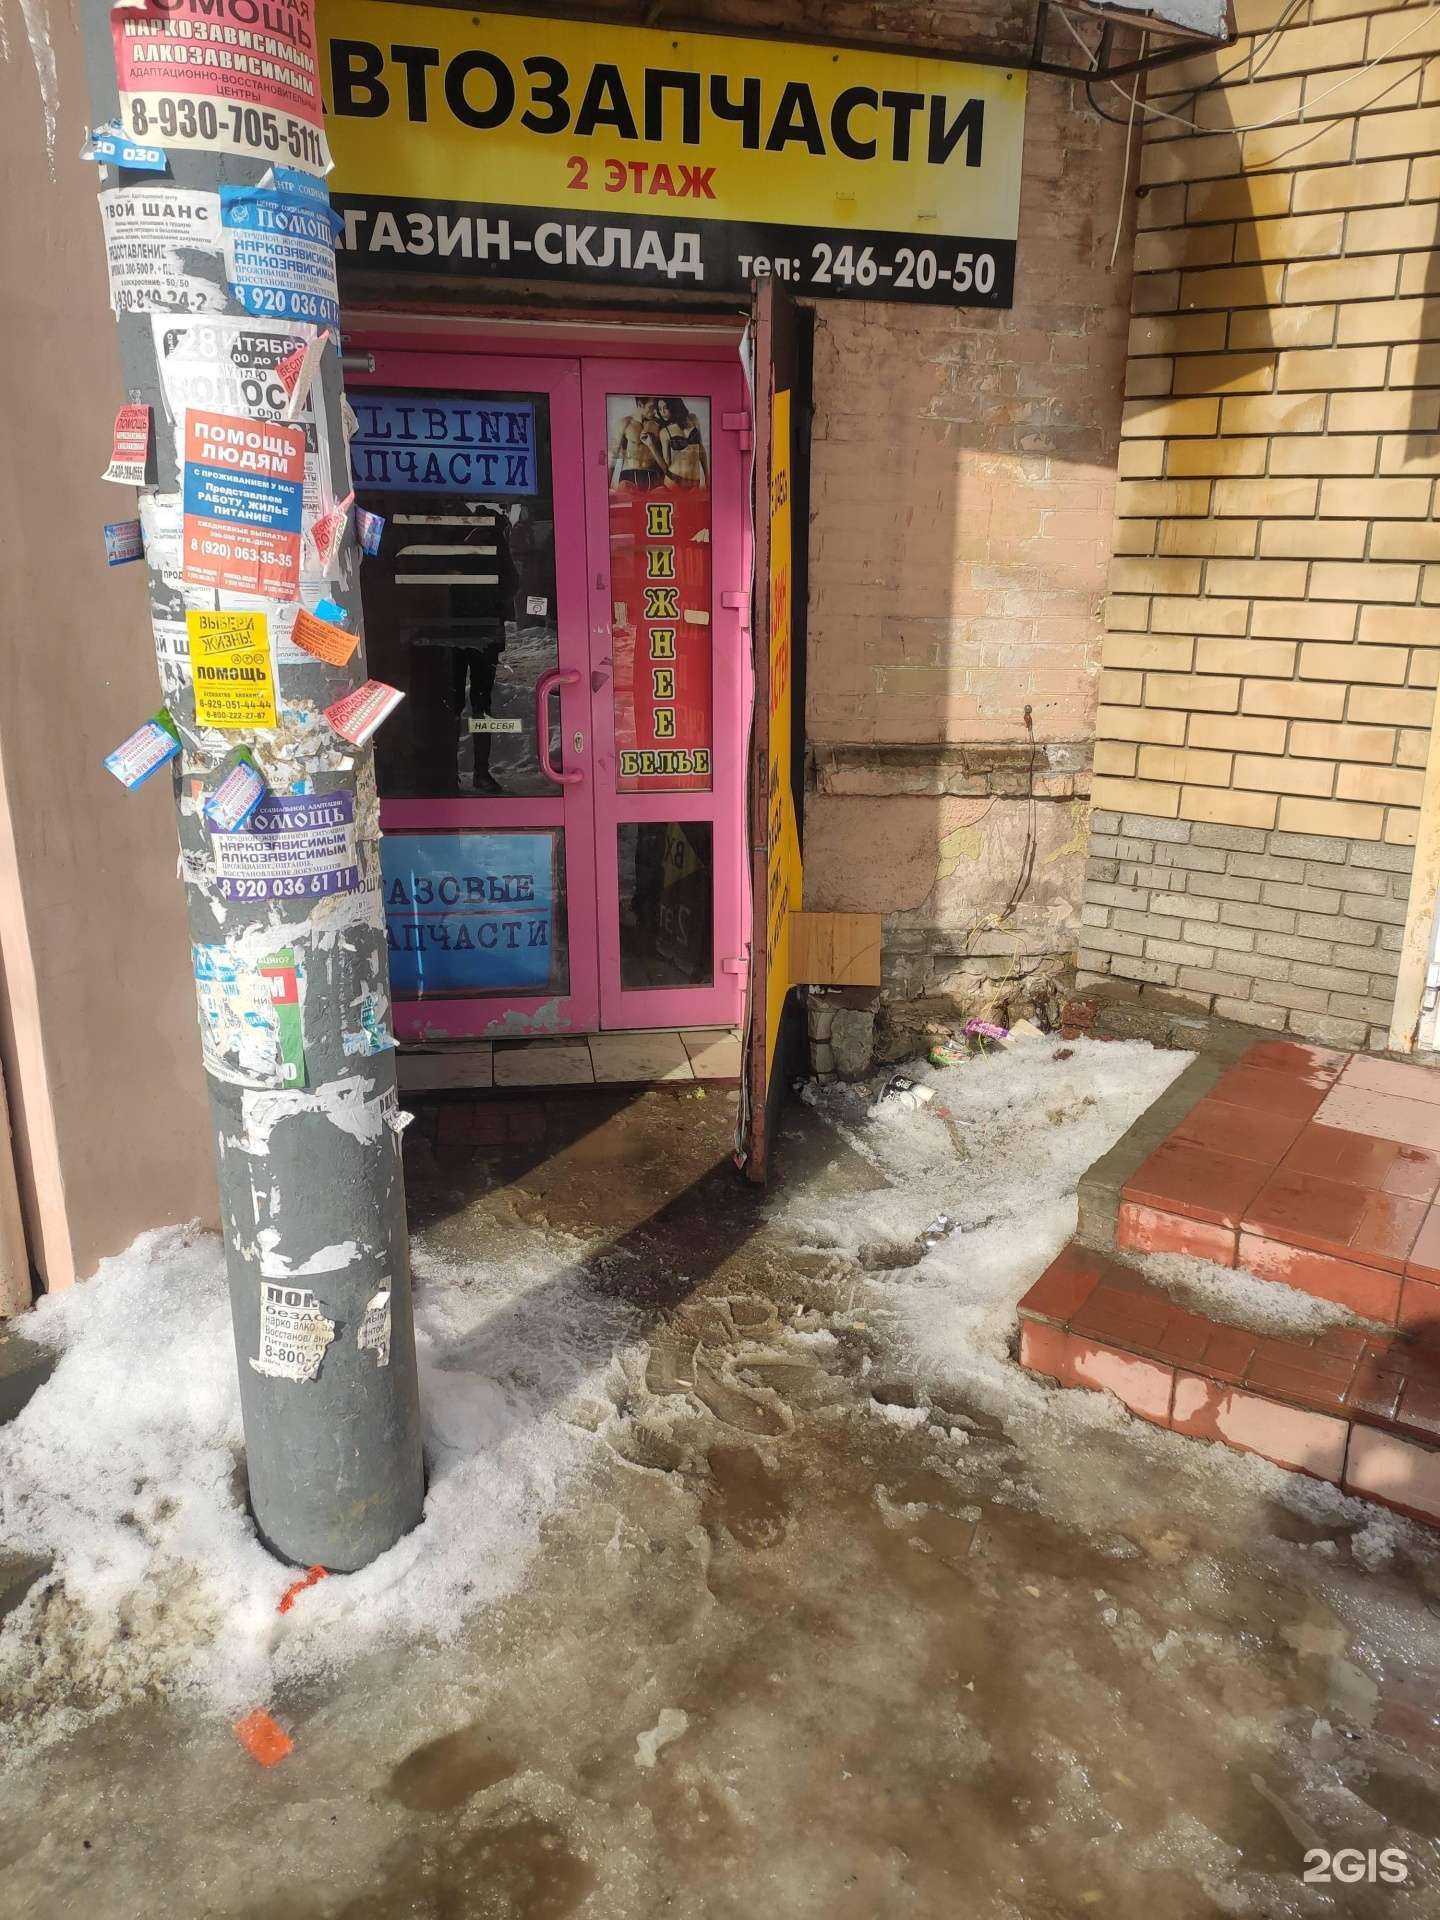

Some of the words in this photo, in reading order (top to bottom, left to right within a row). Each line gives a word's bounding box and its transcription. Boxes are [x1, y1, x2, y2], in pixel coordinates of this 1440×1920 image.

[124, 18, 315, 75] НАРКОЗАВИСИМЫМ
[132, 43, 315, 97] АЛКОЗАВИСИМЫМ
[216, 85, 262, 102] ЦЕНТРЫ
[323, 38, 986, 169] ВТОЗАПЧАСТИ
[132, 97, 325, 168] 8-930-705-5111
[565, 155, 591, 191] 2
[603, 159, 718, 201] ЭТАЖ
[142, 203, 209, 221] ШАНС
[335, 209, 705, 281] ГАЗИН-СКЛАД
[810, 242, 996, 295] 246-20-50
[252, 287, 286, 312] 920
[291, 292, 317, 317] 036
[351, 405, 531, 444] LIBINN
[194, 422, 297, 457] ПОМОЩЬ
[201, 442, 289, 474] ЛЮДЯМ
[205, 482, 283, 504] Представляем
[278, 483, 295, 494] НАС
[197, 492, 245, 509] РАБОТУ,
[248, 501, 289, 516] ЖИЛЬЕ
[214, 505, 272, 523] ПИТАНИЕ!
[190, 538, 198, 551] 8
[201, 540, 231, 559] (920)
[234, 546, 293, 567] 063-35-35
[643, 502, 681, 739] НИЖНЕЕ
[197, 666, 266, 682] ПОМОЩЬ
[475, 722, 487, 731] НА
[490, 721, 515, 731] СЕБЯ
[620, 749, 710, 776] БЕЛЬЕ
[249, 808, 345, 831] ОМОЩЬ
[219, 833, 347, 852] НАРКОЗАВИСИМЫМ
[221, 843, 347, 863] АЛКОЗАВИСИМЫМ
[222, 879, 231, 896] 8
[236, 879, 268, 898] 920
[272, 877, 306, 897] 036
[310, 875, 329, 893] 61
[335, 868, 351, 888] 11
[382, 874, 535, 906] АЗОВЫЕ
